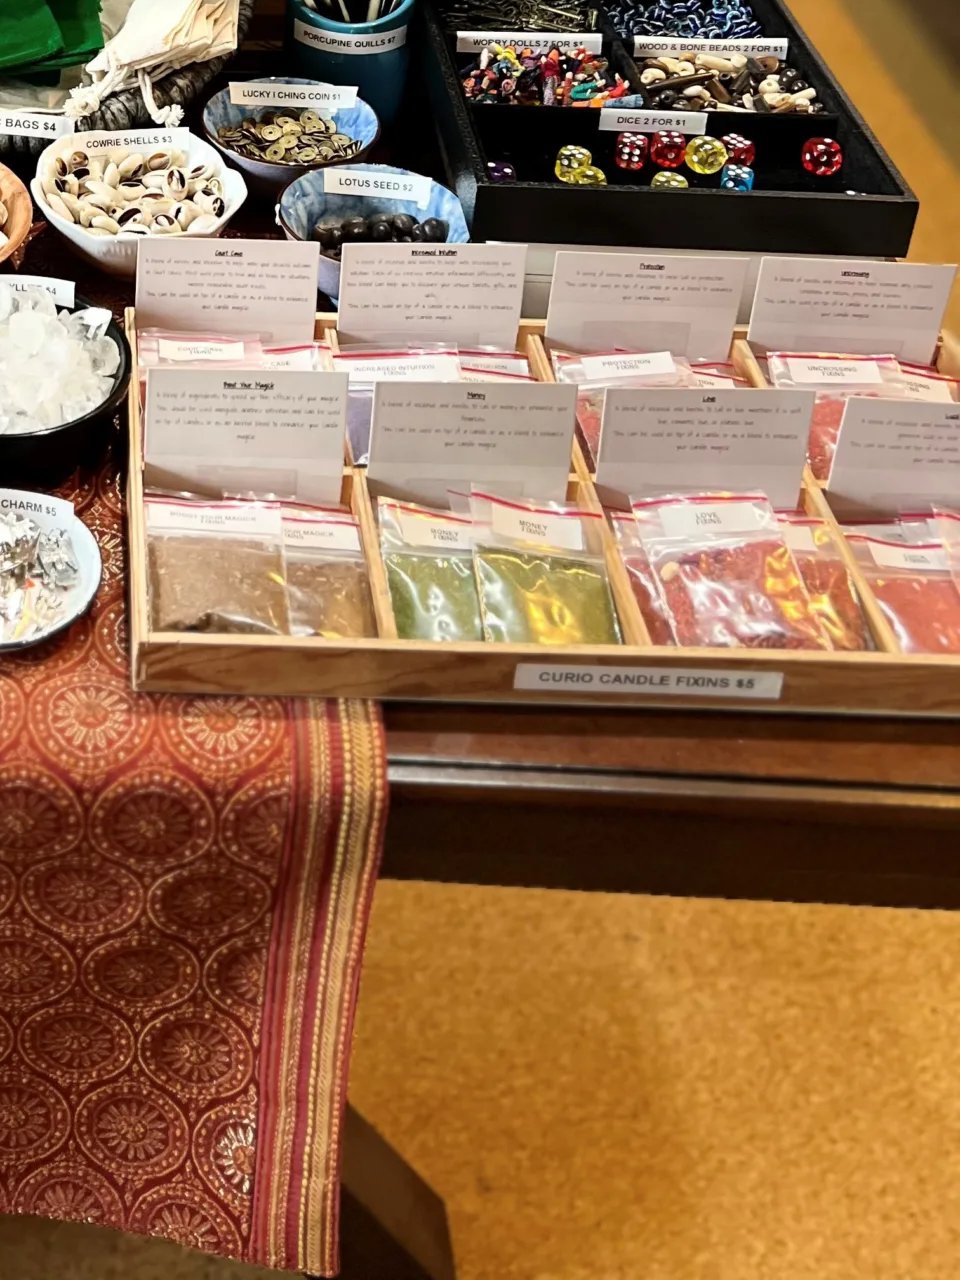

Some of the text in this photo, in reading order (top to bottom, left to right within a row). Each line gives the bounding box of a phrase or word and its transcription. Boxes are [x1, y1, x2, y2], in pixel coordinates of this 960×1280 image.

[303, 30, 352, 48] PORCUPINE
[354, 39, 387, 48] QUILLS
[639, 42, 668, 51] WOOD
[679, 43, 706, 51] BONE
[708, 44, 741, 52] BEADS
[242, 90, 271, 98] LUCKY
[277, 91, 306, 100] CHING
[307, 92, 330, 100] COIN
[5, 118, 39, 130] BAGS
[43, 121, 56, 132] $4
[616, 116, 641, 125] DICE
[651, 118, 673, 126] FOR
[86, 135, 172, 148] COWRIE SHELLS $3
[339, 177, 414, 192] LOTUS SEED $2
[0, 499, 42, 513] CHARM
[45, 506, 56, 516] $5
[695, 512, 719, 520] LOVE
[538, 671, 754, 689] CURIO CANDLE FIXINS $5
